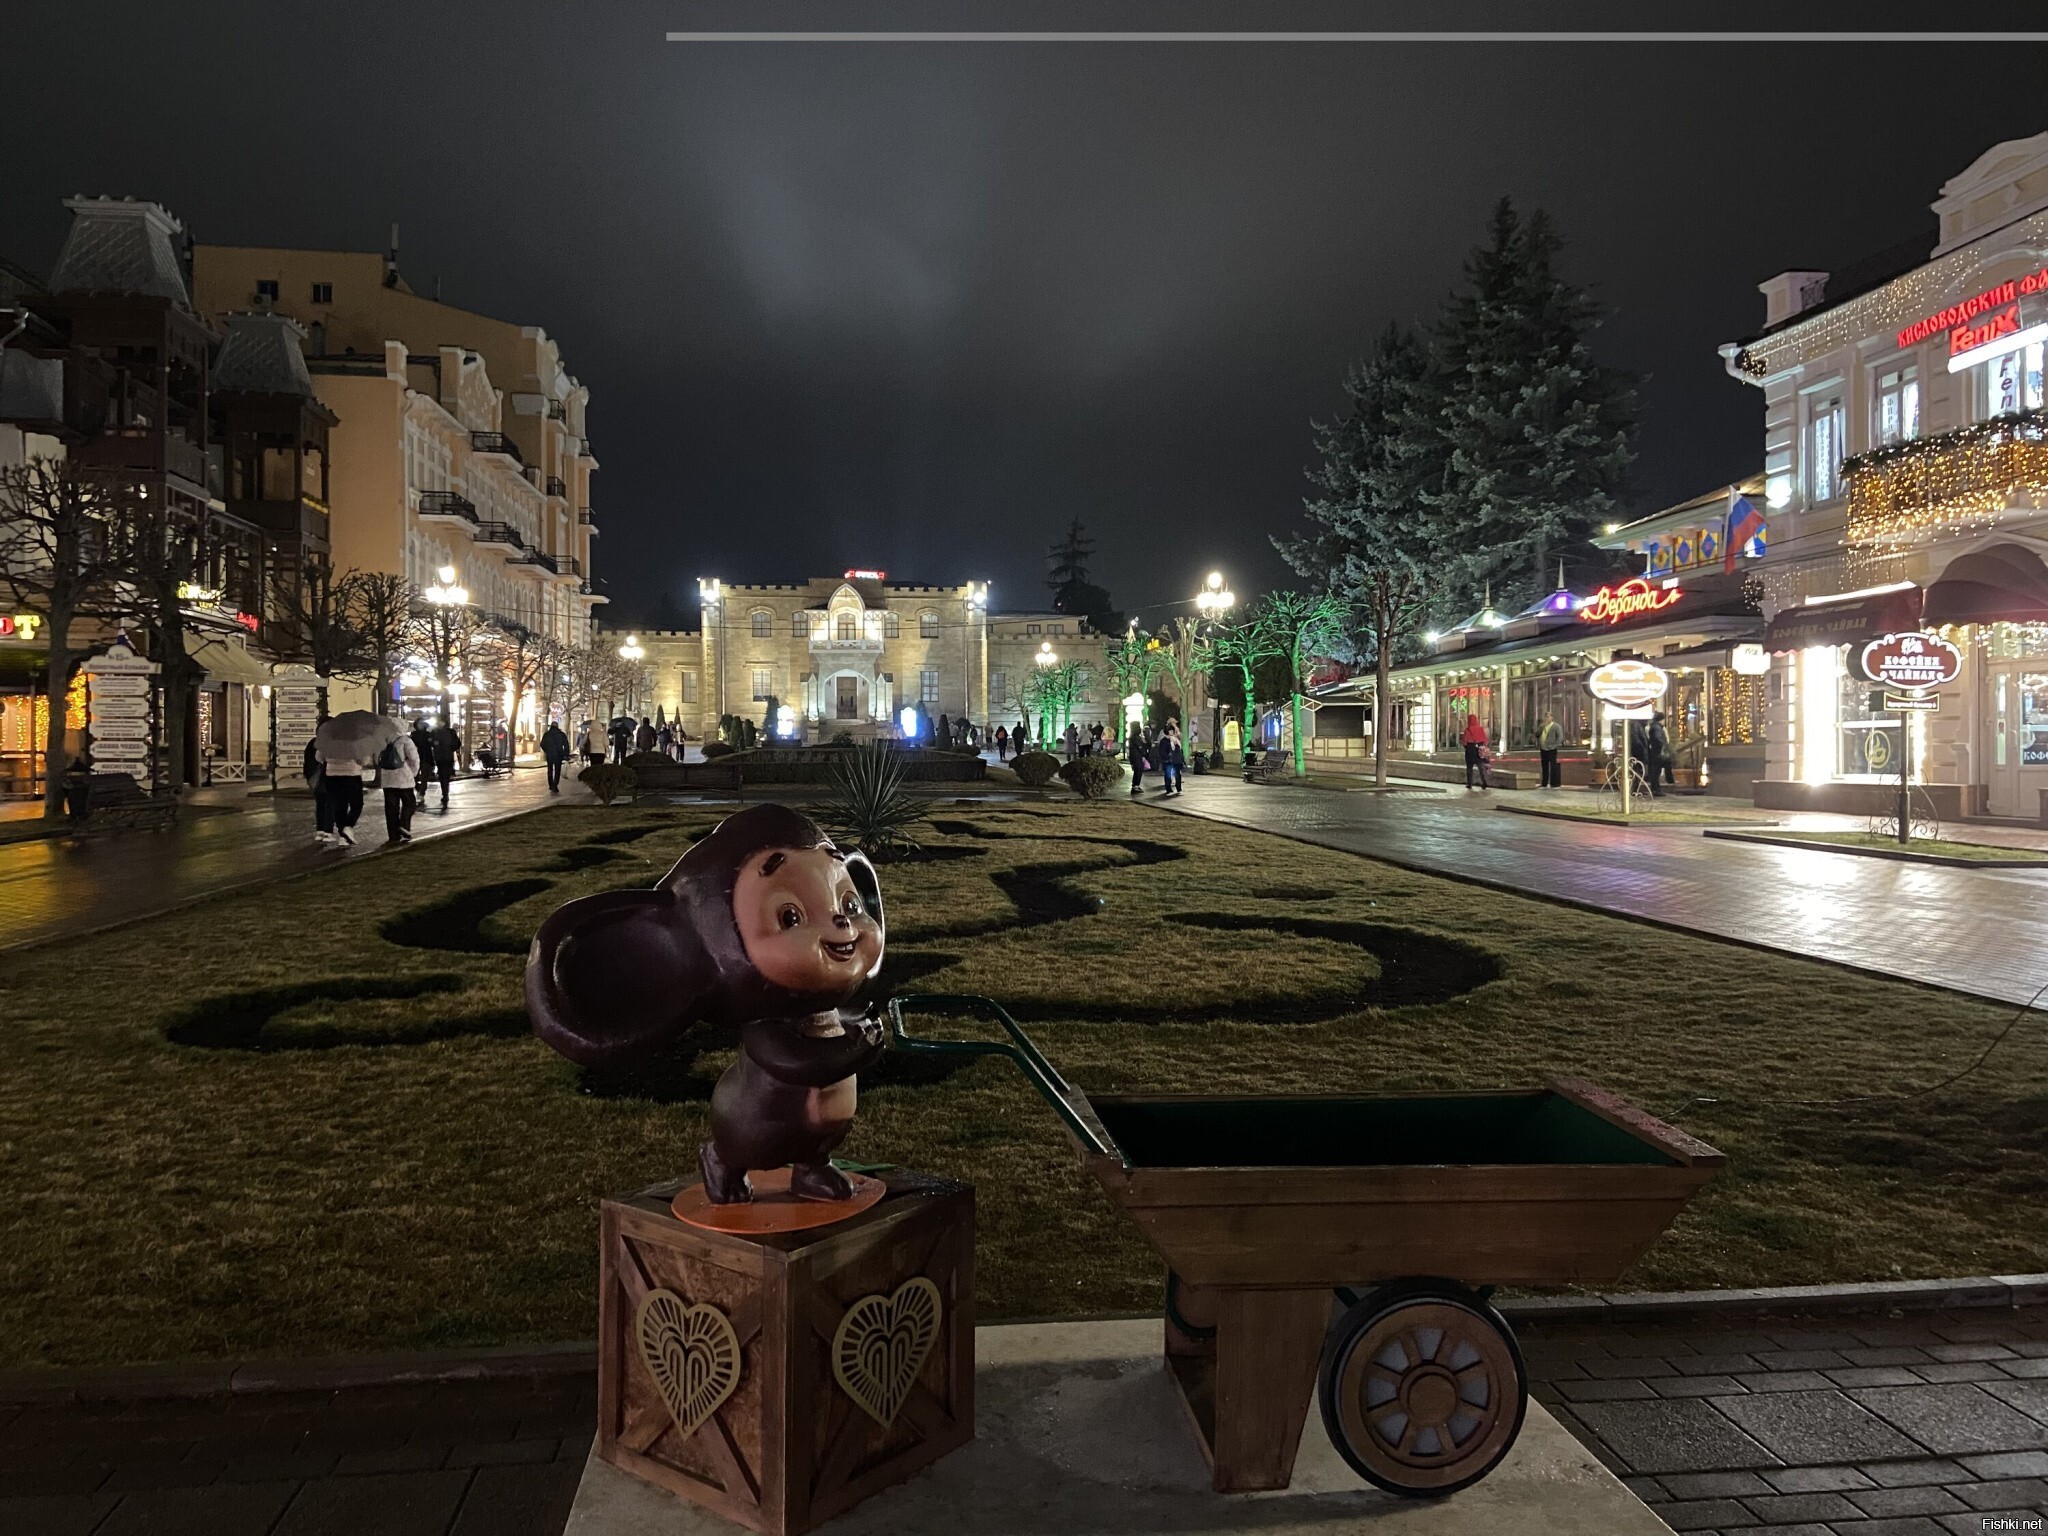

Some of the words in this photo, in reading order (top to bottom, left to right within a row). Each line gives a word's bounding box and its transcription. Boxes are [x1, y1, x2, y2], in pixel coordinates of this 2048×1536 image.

[1581, 579, 1680, 624] Веранда
[1888, 669, 1936, 680] ЧАЙНАЯ
[2024, 751, 2048, 760] КОФ
